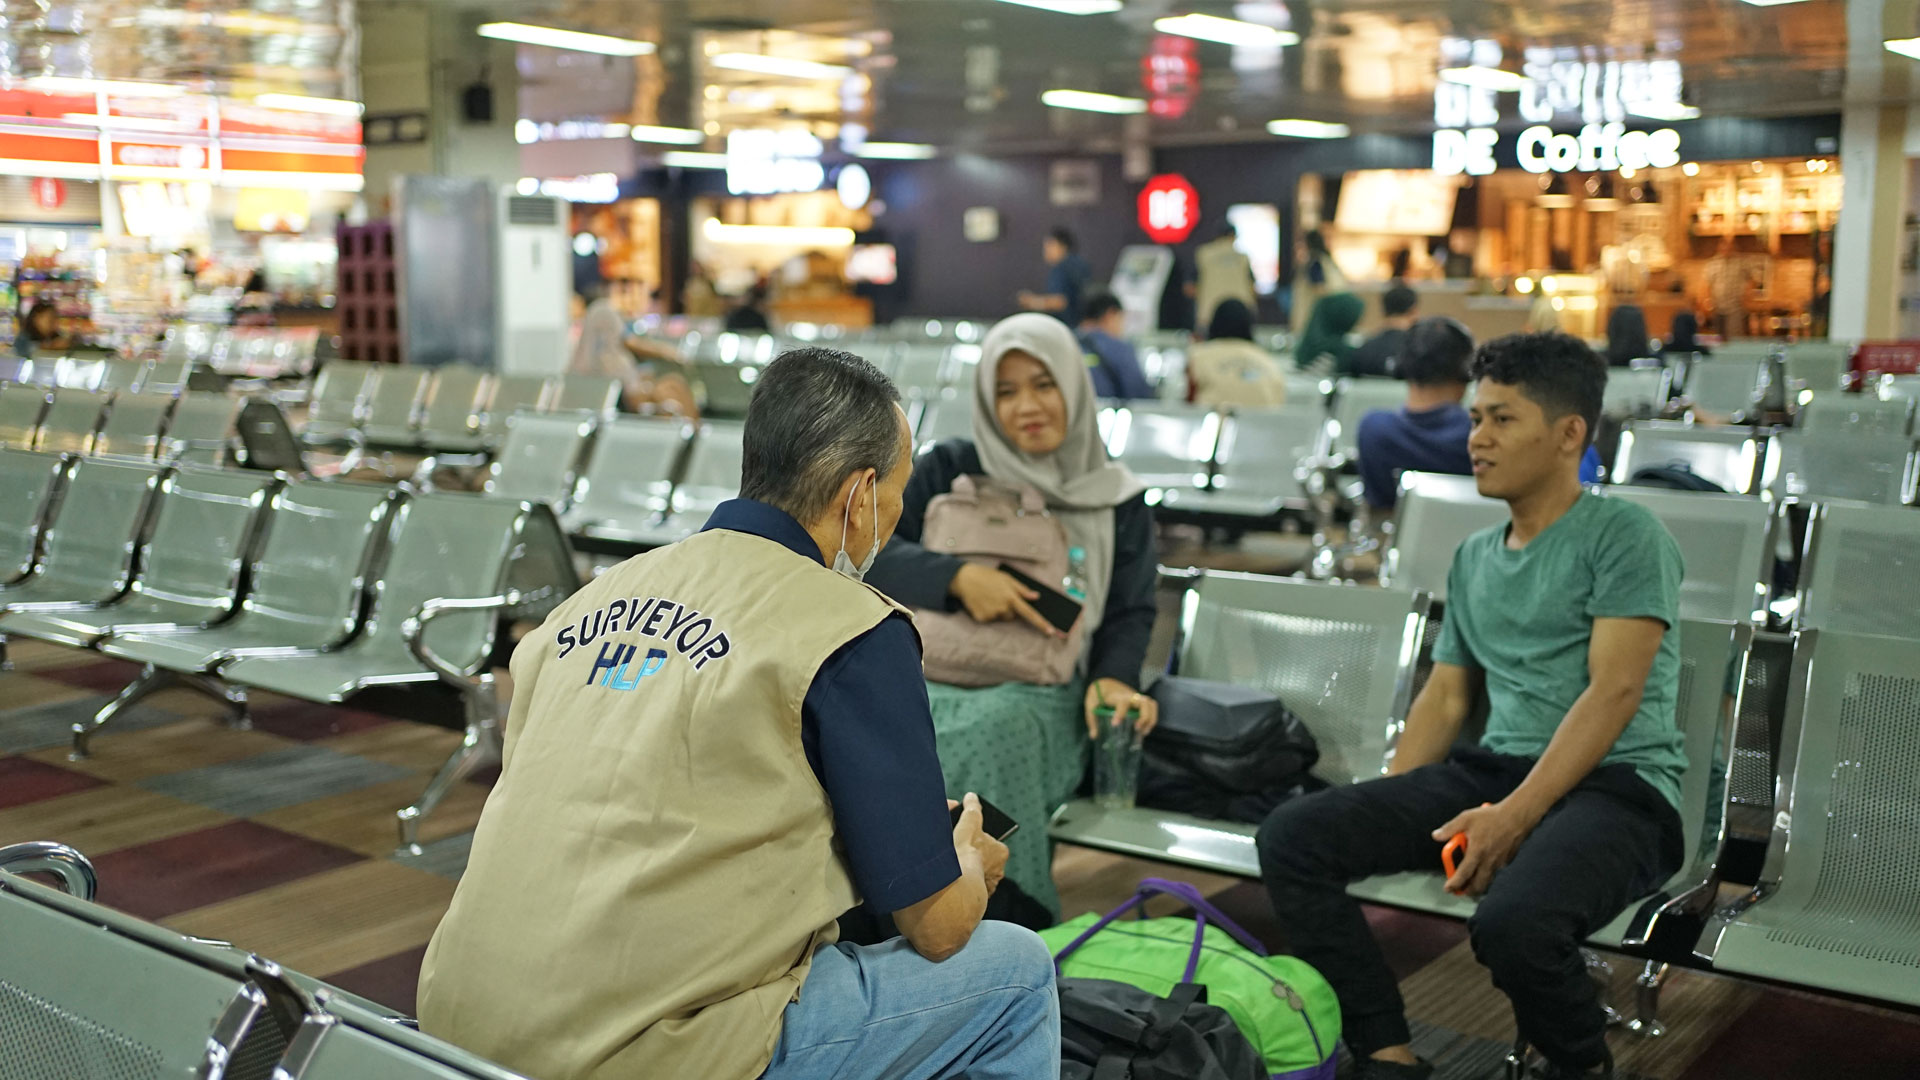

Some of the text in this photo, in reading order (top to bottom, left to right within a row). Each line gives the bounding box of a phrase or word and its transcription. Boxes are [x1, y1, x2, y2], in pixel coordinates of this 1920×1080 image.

[1432, 122, 1681, 176] DE Coffee
[556, 597, 731, 672] SURVEYOR
[586, 641, 668, 691] HLP
